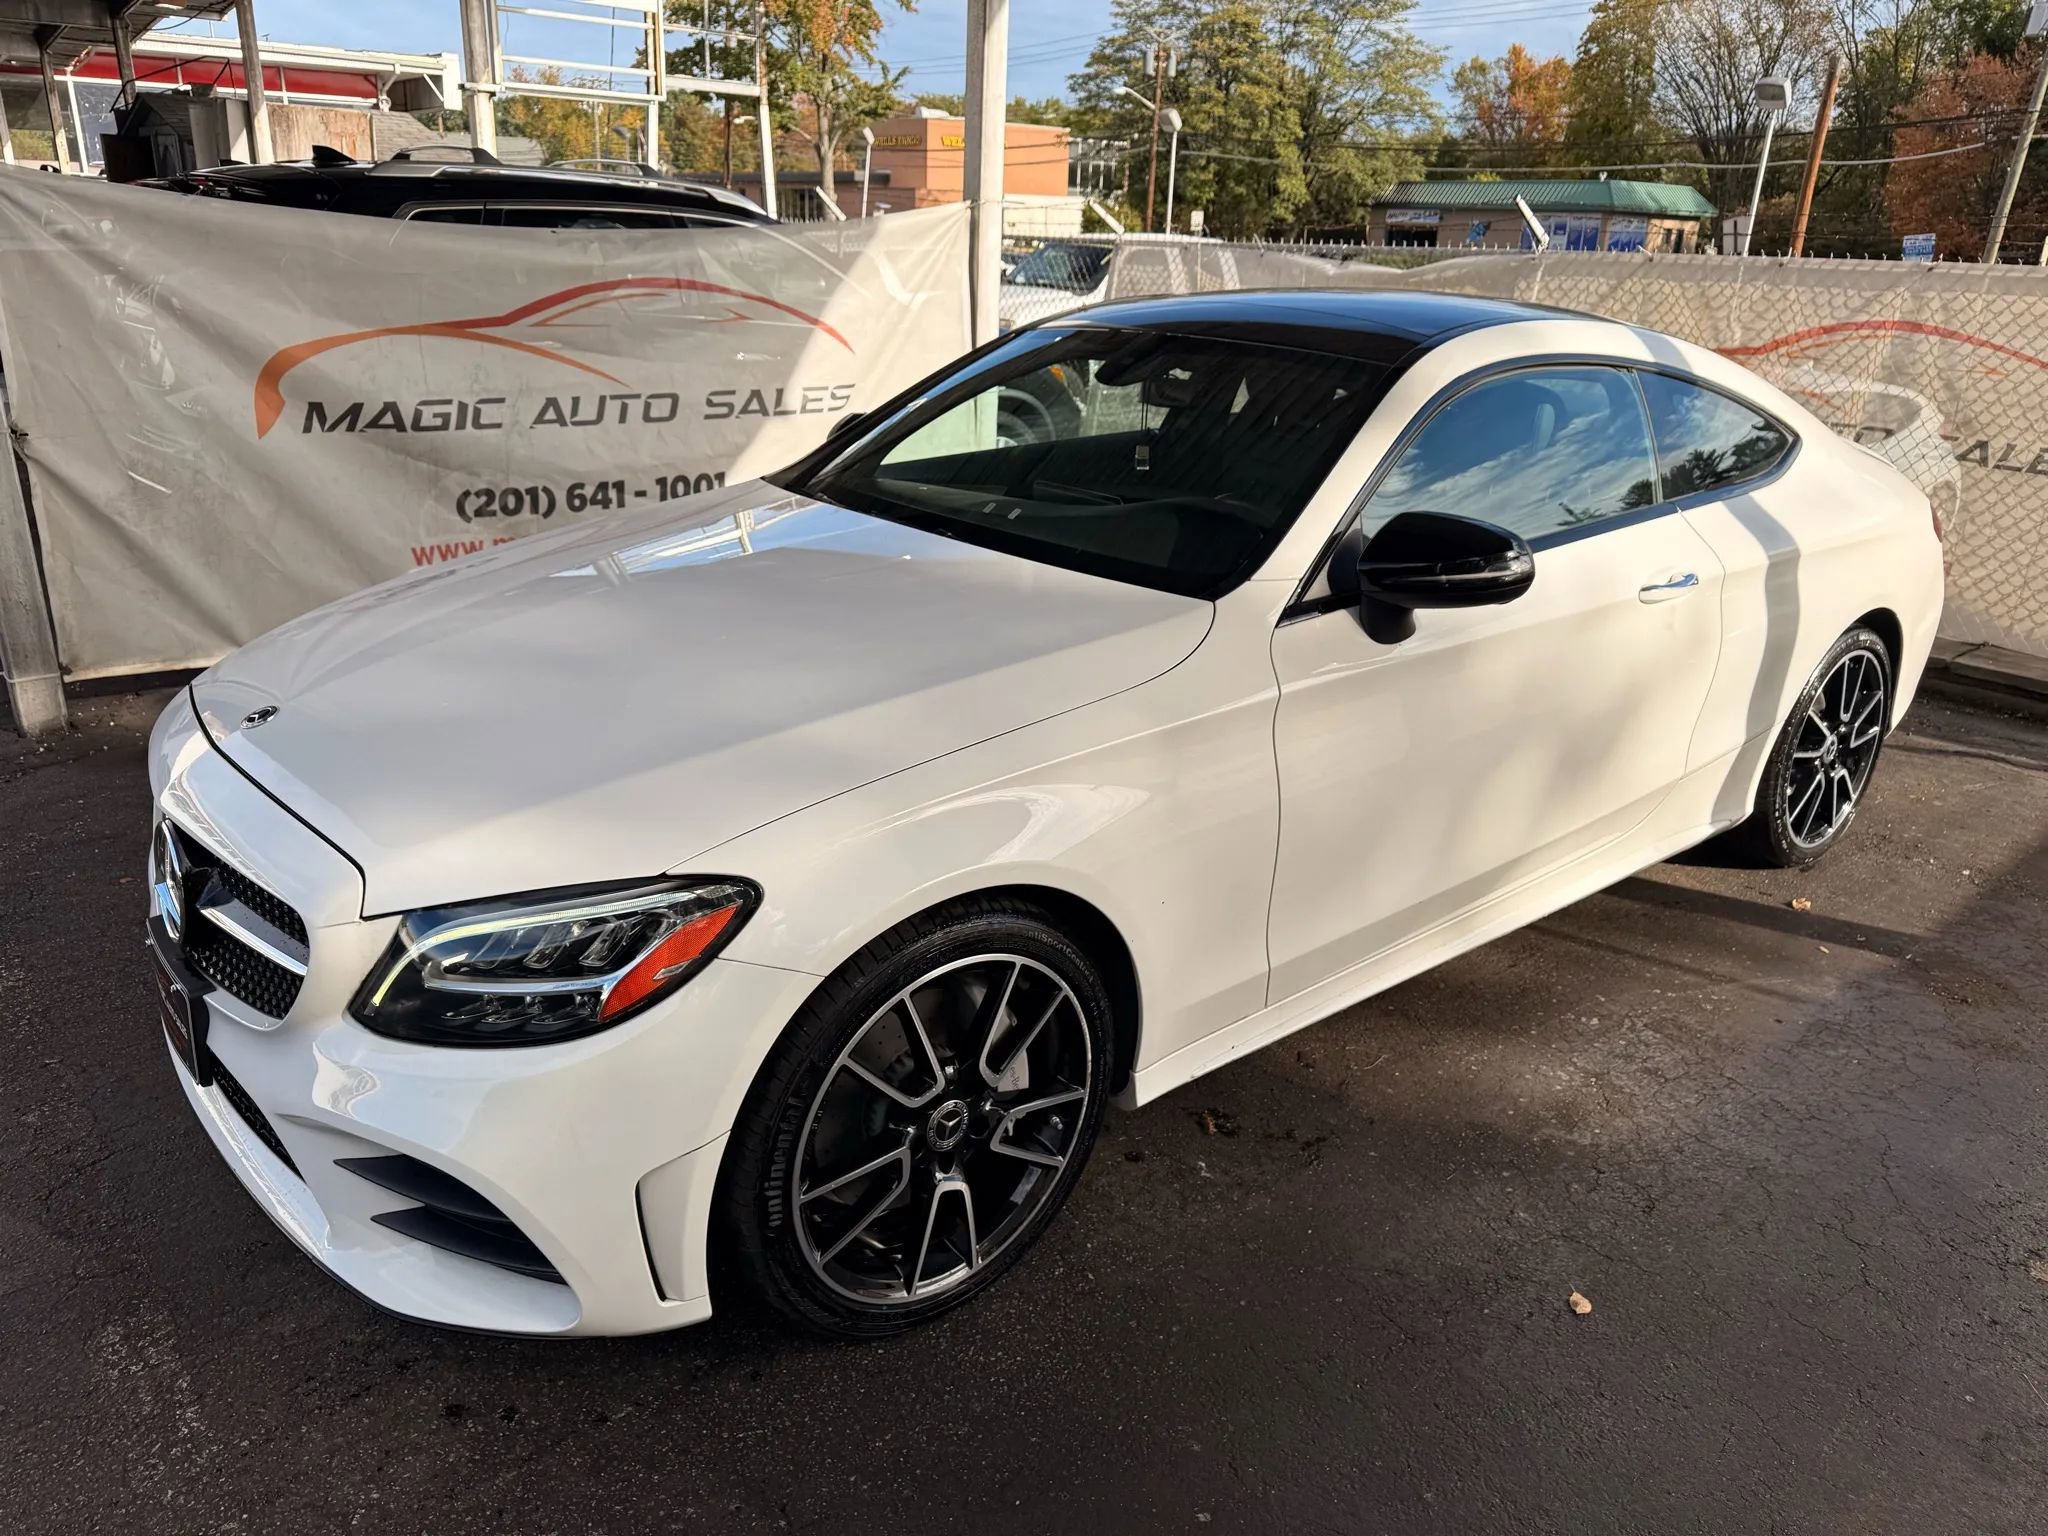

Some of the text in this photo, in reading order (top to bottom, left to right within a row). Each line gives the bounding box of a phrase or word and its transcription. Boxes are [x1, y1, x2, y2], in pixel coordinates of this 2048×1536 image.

[301, 383, 856, 434] MAGIC AUTO SALES
[1938, 433, 2048, 475] ALE
[455, 485, 557, 524] (201)
[565, 479, 626, 513] 641
[655, 471, 726, 502] 1001
